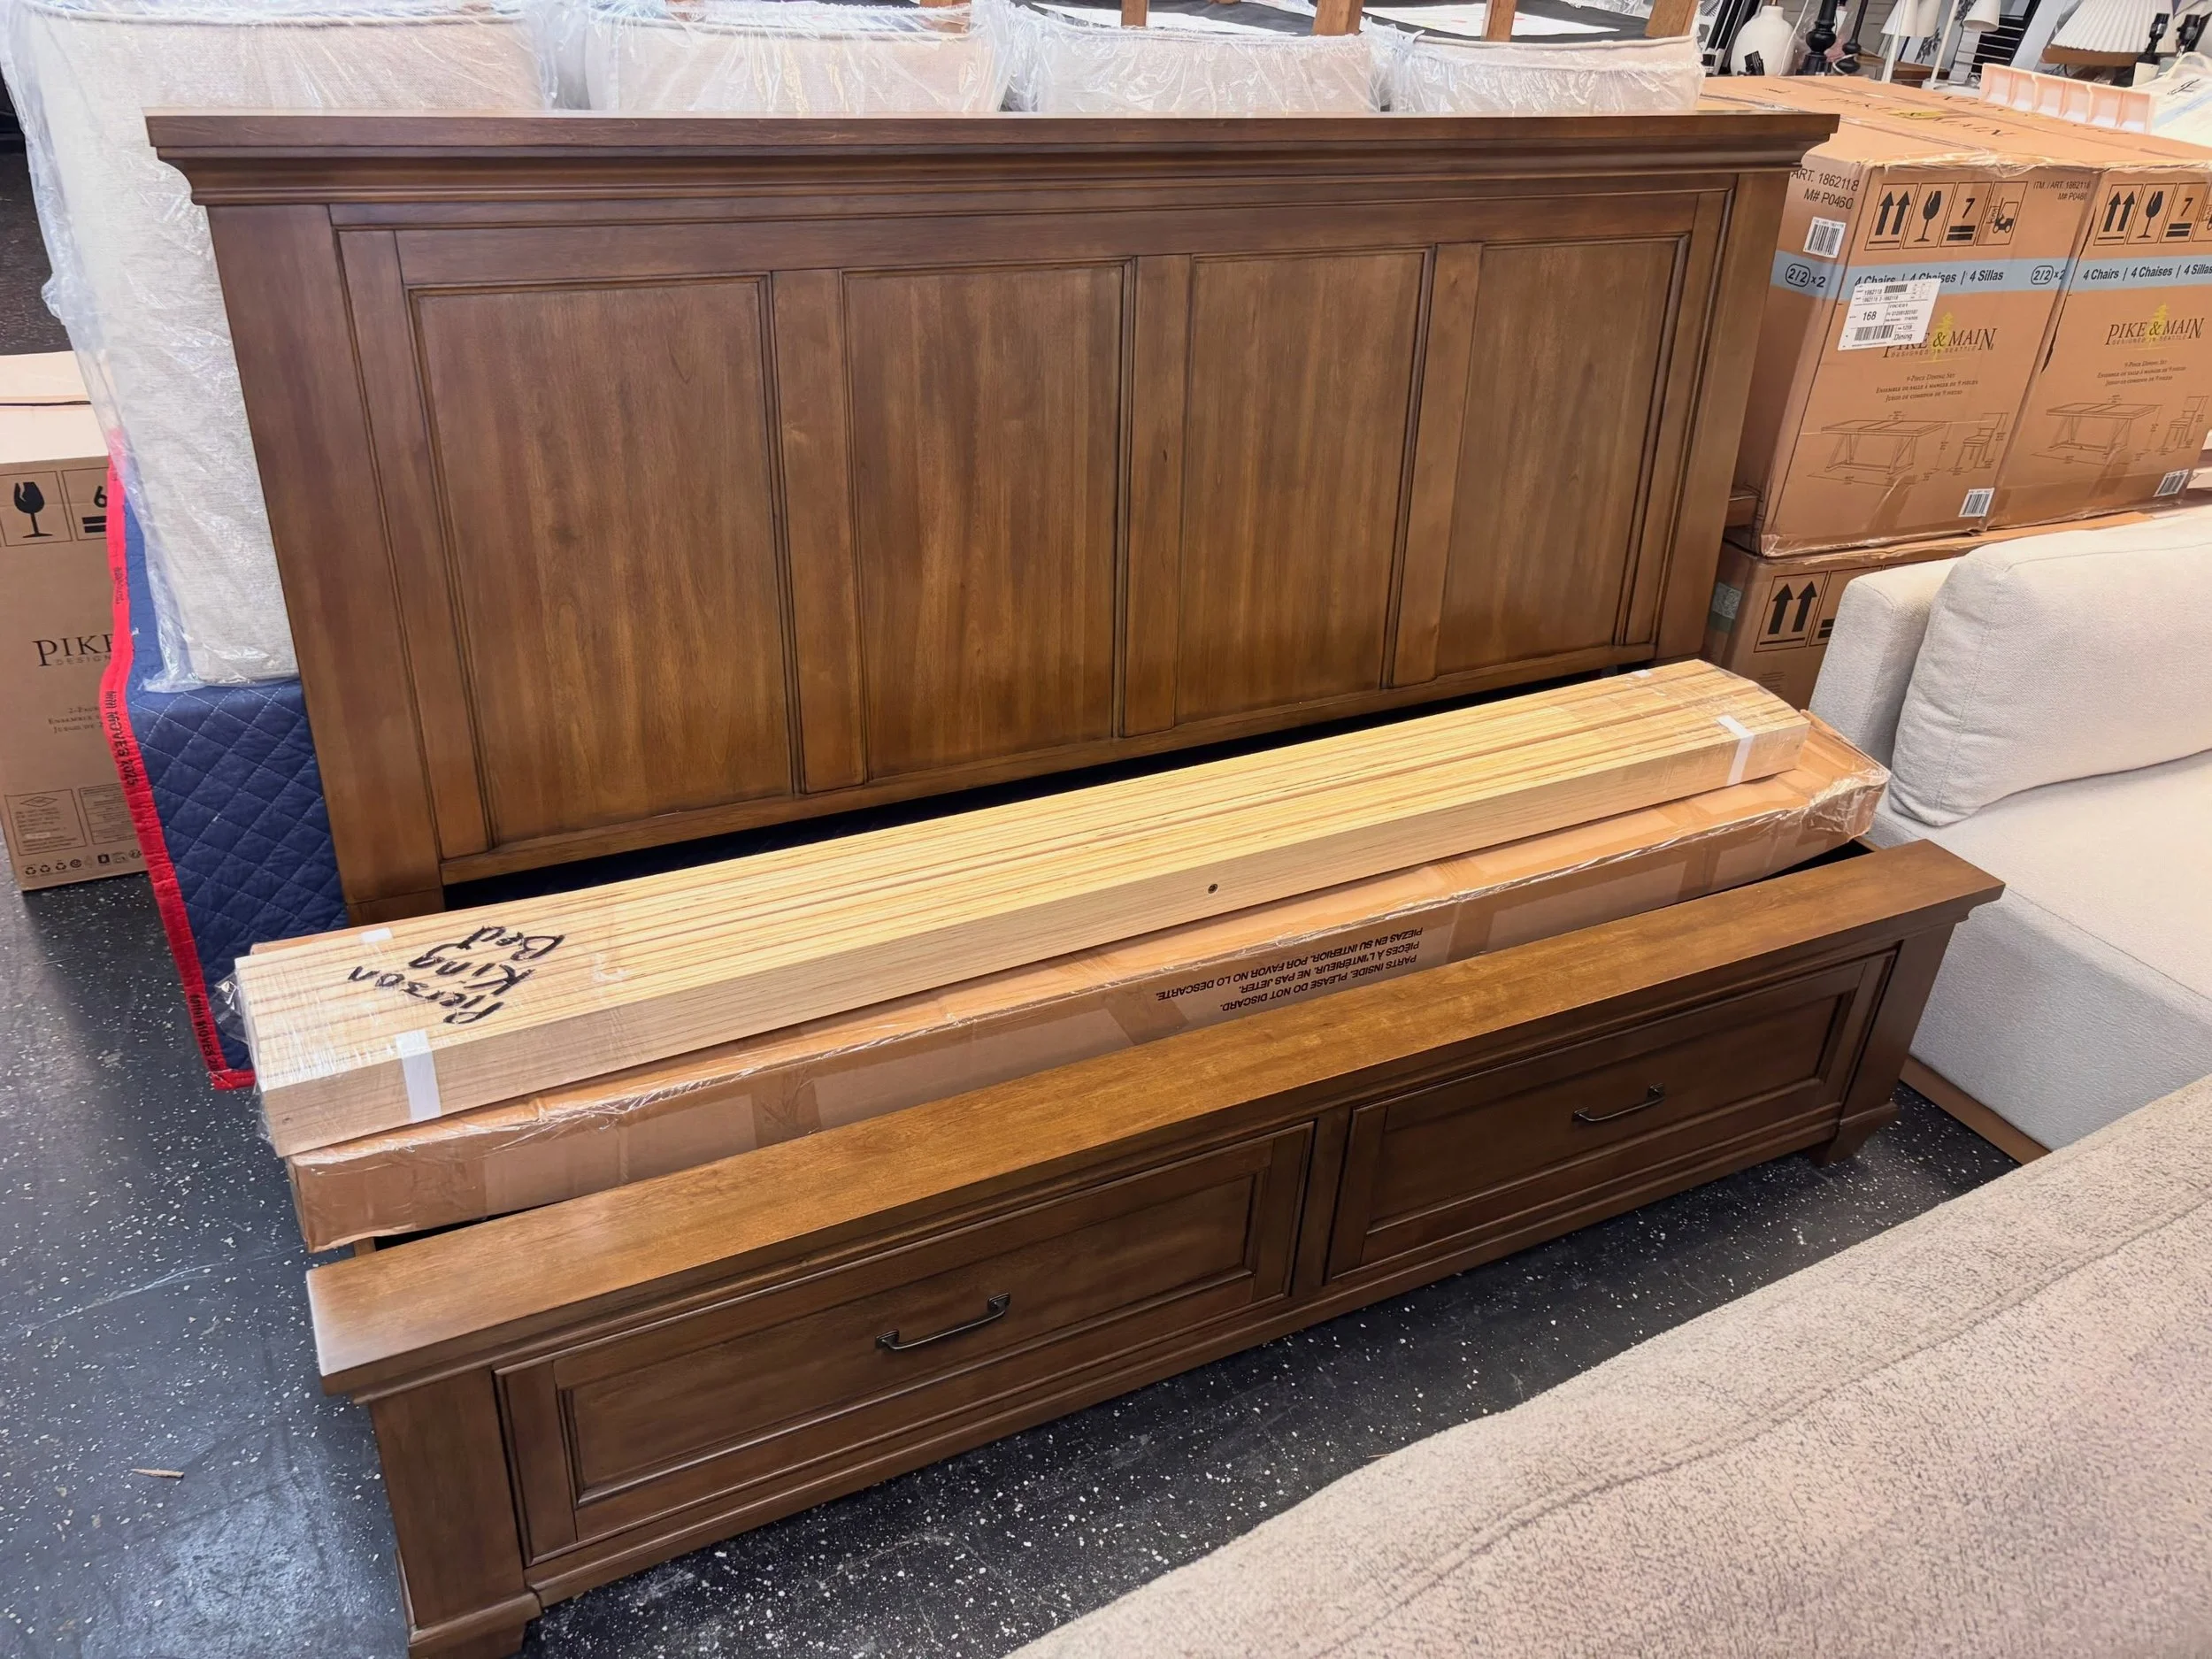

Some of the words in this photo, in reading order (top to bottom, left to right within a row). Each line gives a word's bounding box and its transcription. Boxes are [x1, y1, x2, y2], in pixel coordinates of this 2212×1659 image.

[1818, 173, 1860, 192] 1862118
[1803, 188, 1821, 202] M#
[1821, 192, 1855, 210] P0460
[1962, 198, 1976, 219] 7
[2181, 198, 2193, 217] 7
[1970, 271, 1976, 281] 4
[1978, 269, 2004, 281] Sillas
[2083, 269, 2089, 280] 4
[2091, 268, 2119, 280] Chairs
[2131, 266, 2138, 278] 4
[2139, 265, 2173, 278] Chaises
[2184, 265, 2191, 275] 4
[2191, 264, 2212, 275] Sillas
[1863, 311, 1877, 321] 168
[1894, 333, 1913, 342] Dining
[1932, 331, 1947, 347] &
[1948, 327, 1998, 350] MAIN
[2105, 321, 2147, 345] PIKE
[2148, 320, 2163, 336] &
[2162, 318, 2205, 339] MAIN
[94, 486, 107, 508] 6
[1375, 937, 1388, 947] EN
[1390, 927, 1423, 943] PIEZAS
[457, 926, 566, 961] Bed
[1359, 940, 1374, 950] SU
[1386, 941, 1419, 956] PIÈCES
[1310, 943, 1359, 963] INTERIOR.
[1377, 949, 1386, 960] À
[409, 942, 535, 995] King
[1286, 956, 1309, 970] POR
[1386, 955, 1417, 970] PARTS
[1233, 972, 1248, 983] NO
[1250, 962, 1285, 979] FAVOR
[1297, 969, 1311, 979] NE
[1350, 964, 1383, 979] INSIDE.
[1217, 975, 1231, 986] LO
[1239, 978, 1274, 994] JETER.
[1275, 972, 1294, 985] PAS
[1310, 972, 1348, 987] PLEASE
[1156, 979, 1215, 1002] DESCARTE.
[1270, 987, 1292, 1000] NOT
[1294, 985, 1309, 994] DO
[1220, 993, 1267, 1011] DISCARD.
